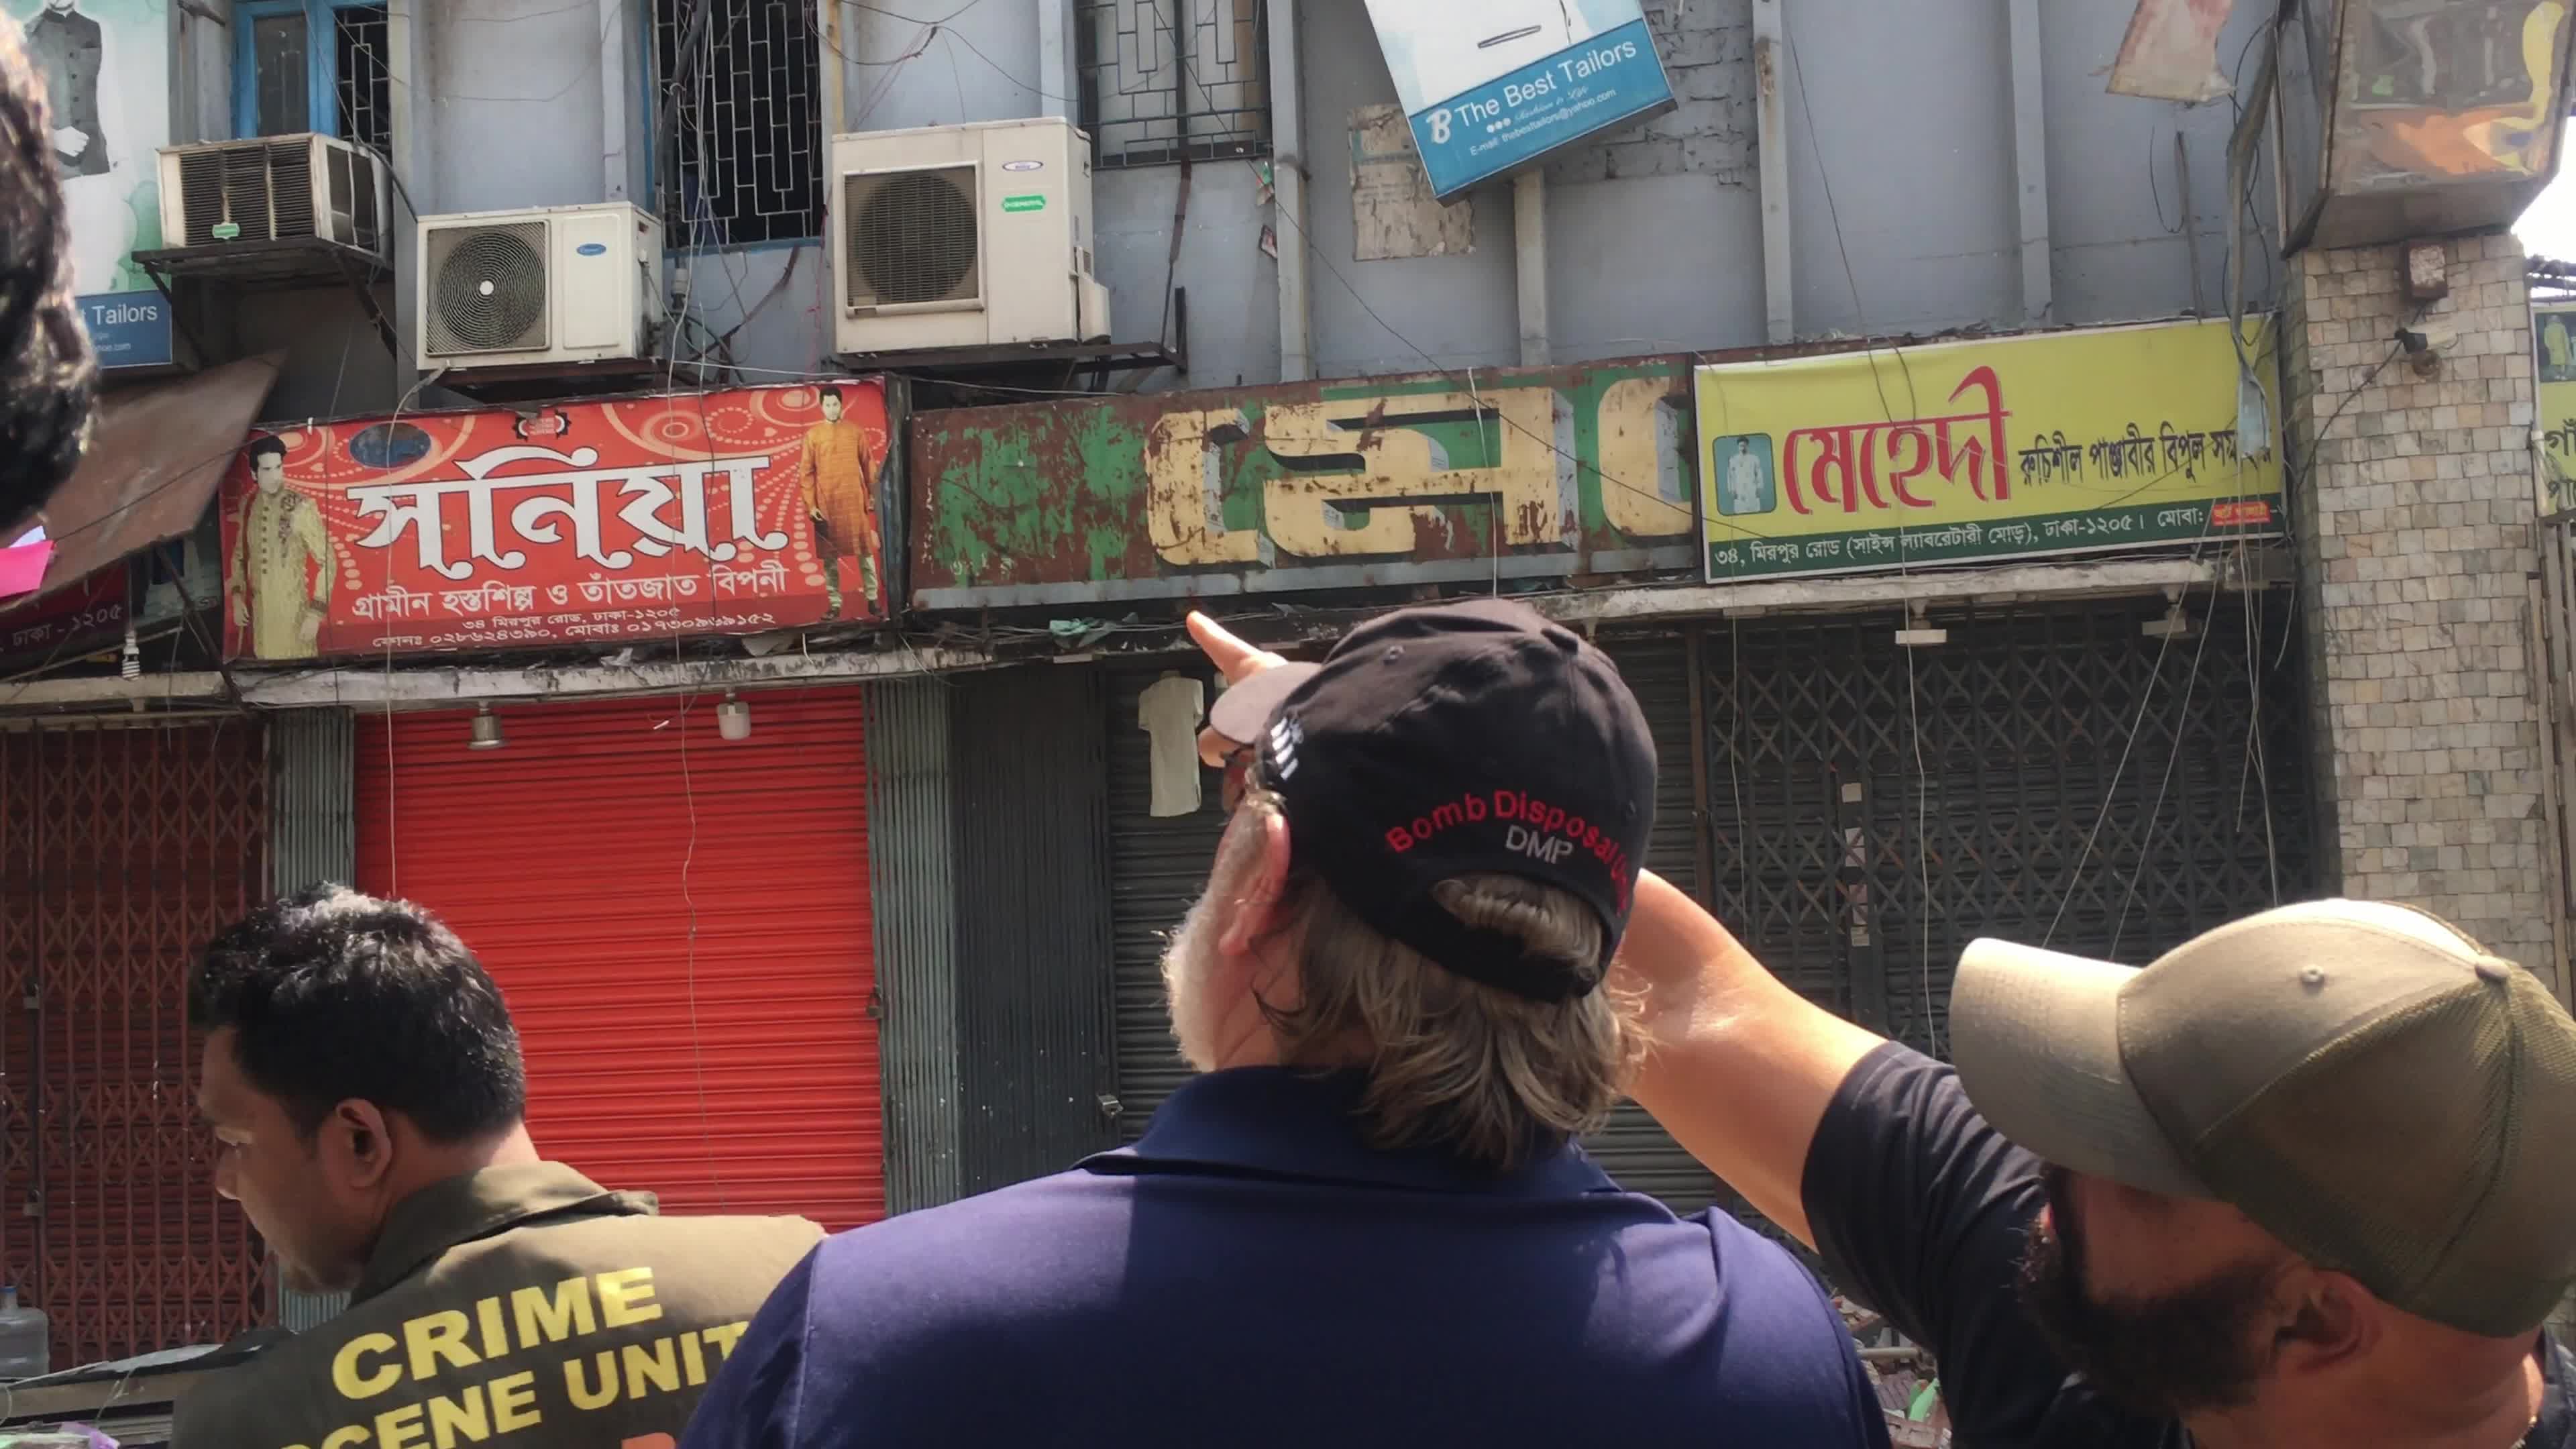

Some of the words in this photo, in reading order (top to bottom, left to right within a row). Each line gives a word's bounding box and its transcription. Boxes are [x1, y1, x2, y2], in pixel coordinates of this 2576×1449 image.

[1454, 98, 1501, 127] The
[1503, 70, 1558, 108] Best
[1558, 40, 1638, 83] Tailors
[91, 303, 158, 325] Tailors
[1783, 364, 2012, 516] মেহেদী
[2018, 429, 2084, 487] রুচিশীল
[2088, 421, 2156, 481] পাঞ্জাবীর
[2158, 420, 2206, 484] বিপুল
[346, 445, 790, 580] সানিয়া
[1750, 540, 1799, 564] মিরপুর
[1805, 539, 1841, 559] রোড
[352, 585, 433, 621] গ্রামীন
[439, 580, 537, 616] হস্তশিল্প
[545, 584, 568, 605] ও
[577, 572, 701, 604] তাঁতজাত
[462, 619, 485, 629] ৩৪
[492, 615, 542, 628] মিরপুর
[1385, 793, 1485, 853] Bomb
[1493, 790, 1619, 865] Disposal
[1505, 824, 1573, 865] DMP
[332, 1267, 663, 1399] CRIME
[280, 1371, 542, 1449] ENE
